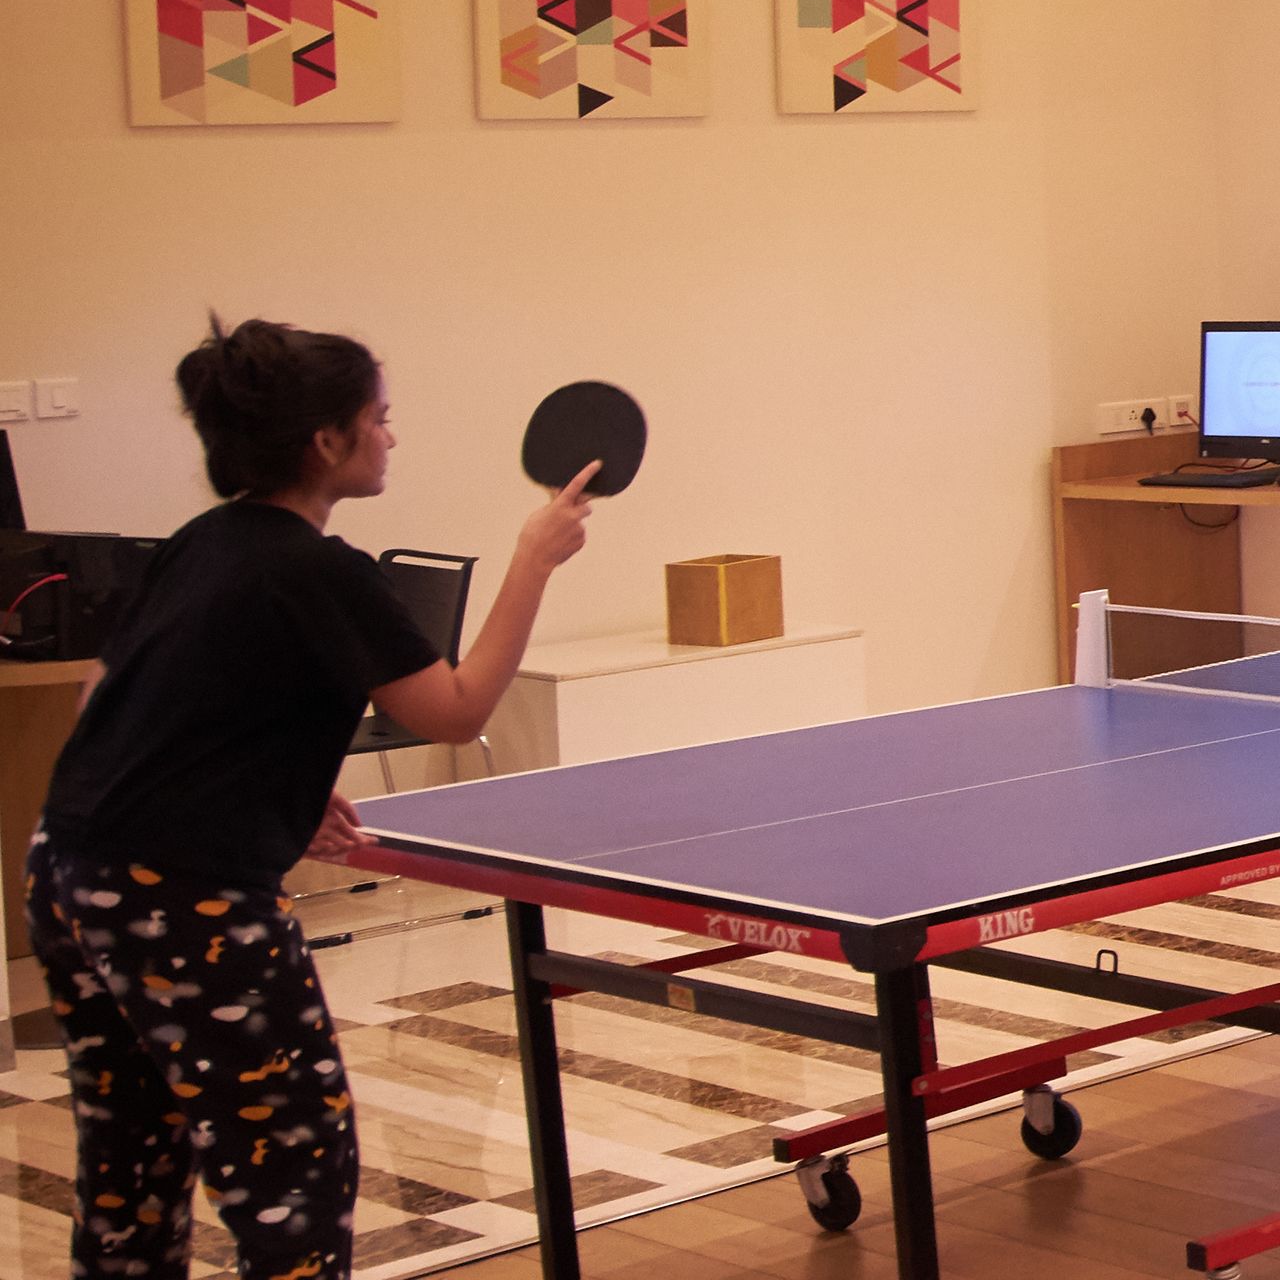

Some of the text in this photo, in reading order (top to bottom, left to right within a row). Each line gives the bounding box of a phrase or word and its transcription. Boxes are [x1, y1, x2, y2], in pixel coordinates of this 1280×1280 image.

[1220, 867, 1268, 886] APPROVED
[1269, 864, 1280, 875] BY
[727, 916, 803, 952] VELOX
[978, 908, 1034, 943] KING
